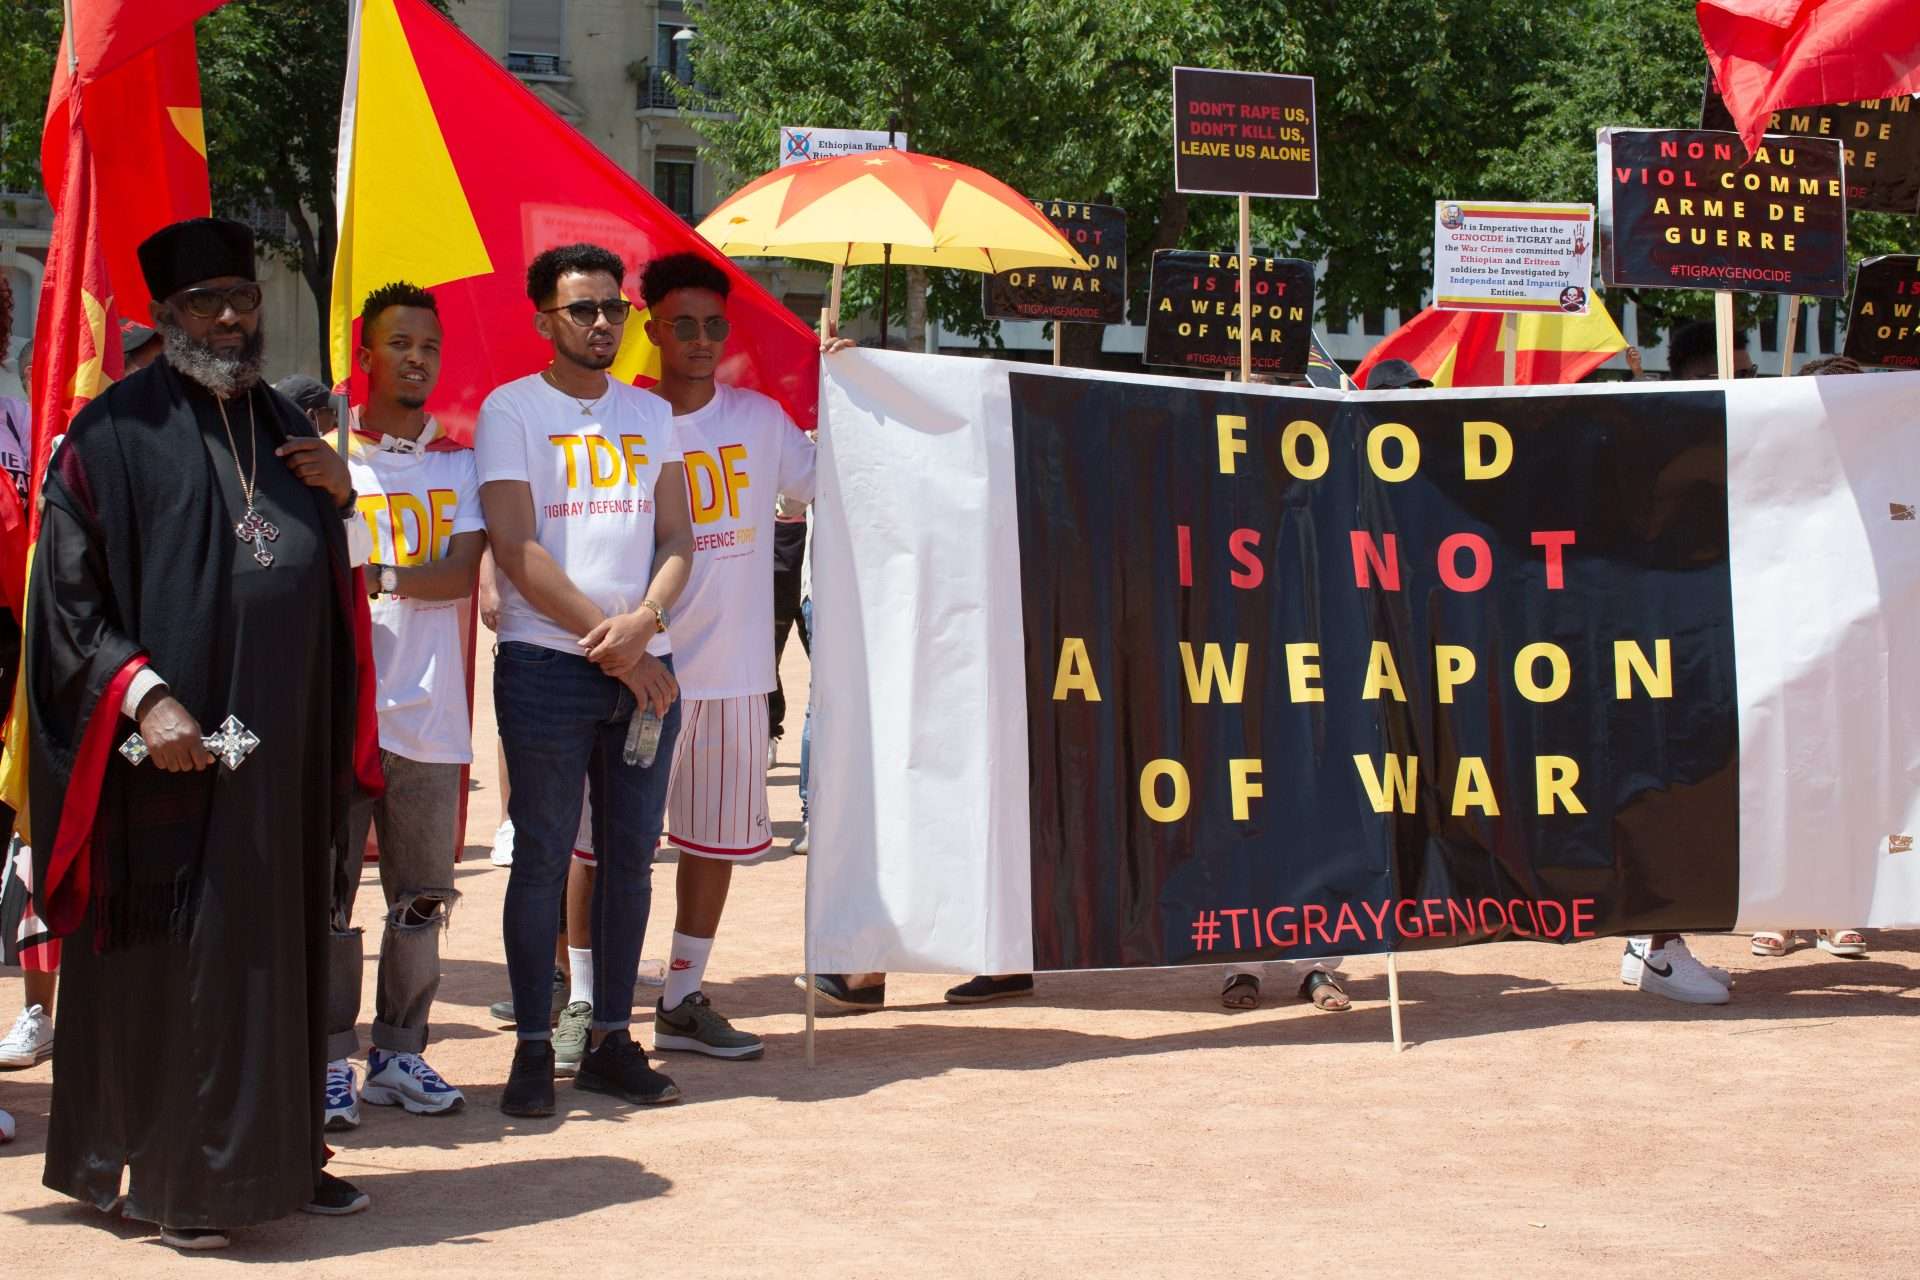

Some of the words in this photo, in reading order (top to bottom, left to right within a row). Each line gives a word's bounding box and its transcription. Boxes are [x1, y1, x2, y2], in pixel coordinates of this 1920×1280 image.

[1189, 101, 1235, 117] DON'T
[1240, 104, 1280, 120] RAPE
[1284, 107, 1310, 125] US,
[1189, 121, 1237, 137] DON'T
[1242, 124, 1276, 140] KILL
[1280, 127, 1305, 144] US,
[1769, 114, 1832, 135] RME
[1855, 120, 1891, 140] DE
[818, 140, 863, 151] Ethiopian
[1181, 141, 1230, 157] LEAVE
[1234, 145, 1256, 159] US
[1260, 146, 1311, 162] ALONE
[1660, 141, 1732, 161] NON
[1755, 147, 1795, 166] AU
[1615, 167, 1697, 188] VIOL
[1721, 172, 1840, 197] COMME
[1653, 197, 1745, 218] ARME
[1769, 204, 1805, 223] DE
[1451, 233, 1504, 243] GENOCIDE
[1505, 235, 1515, 243] in
[1516, 236, 1553, 244] TIGRAY
[1555, 237, 1571, 245] and
[1478, 223, 1528, 234] Imperative
[1530, 225, 1548, 233] that
[1549, 226, 1564, 234] the
[1664, 227, 1795, 252] GUERRE
[1460, 255, 1503, 266] Ethiopian
[1505, 257, 1521, 265] and
[1523, 258, 1561, 266] Eritrean
[1461, 244, 1478, 252] War
[1480, 245, 1513, 254] Crimes
[1515, 246, 1564, 255] committed
[1566, 248, 1576, 257] by
[1009, 272, 1037, 288] OF
[1052, 275, 1101, 292] WAR
[1192, 275, 1217, 291] IS
[1449, 276, 1506, 287] Independent
[1507, 278, 1524, 286] and
[1526, 278, 1569, 288] Impartial
[1450, 266, 1486, 274] soldiers
[1488, 267, 1499, 275] be
[1501, 268, 1556, 278] Investigated
[1558, 269, 1570, 279] by
[1670, 264, 1792, 283] #TIGRAYGENOCIDE
[1490, 289, 1527, 297] Entities.
[1159, 298, 1173, 312] A
[1191, 299, 1303, 321] WEAPON
[1860, 301, 1874, 316] A
[1178, 322, 1208, 338] OF
[1226, 325, 1282, 343] WAR
[1877, 325, 1909, 340] OF
[1216, 414, 1514, 483] FOOD
[548, 434, 649, 489] TDF
[684, 443, 750, 524] DF
[543, 501, 584, 519] TIGIRAY
[589, 499, 634, 514] DEFENCE
[356, 488, 458, 568] TDF
[1176, 524, 1265, 590] IS
[1350, 529, 1576, 593] NOT
[1052, 637, 1102, 702] A
[1179, 638, 1673, 704] WEAPON
[1139, 758, 1264, 823] OF
[1353, 753, 1588, 817] WAR
[1190, 897, 1596, 952] #TIGRAYGENOCIDE
